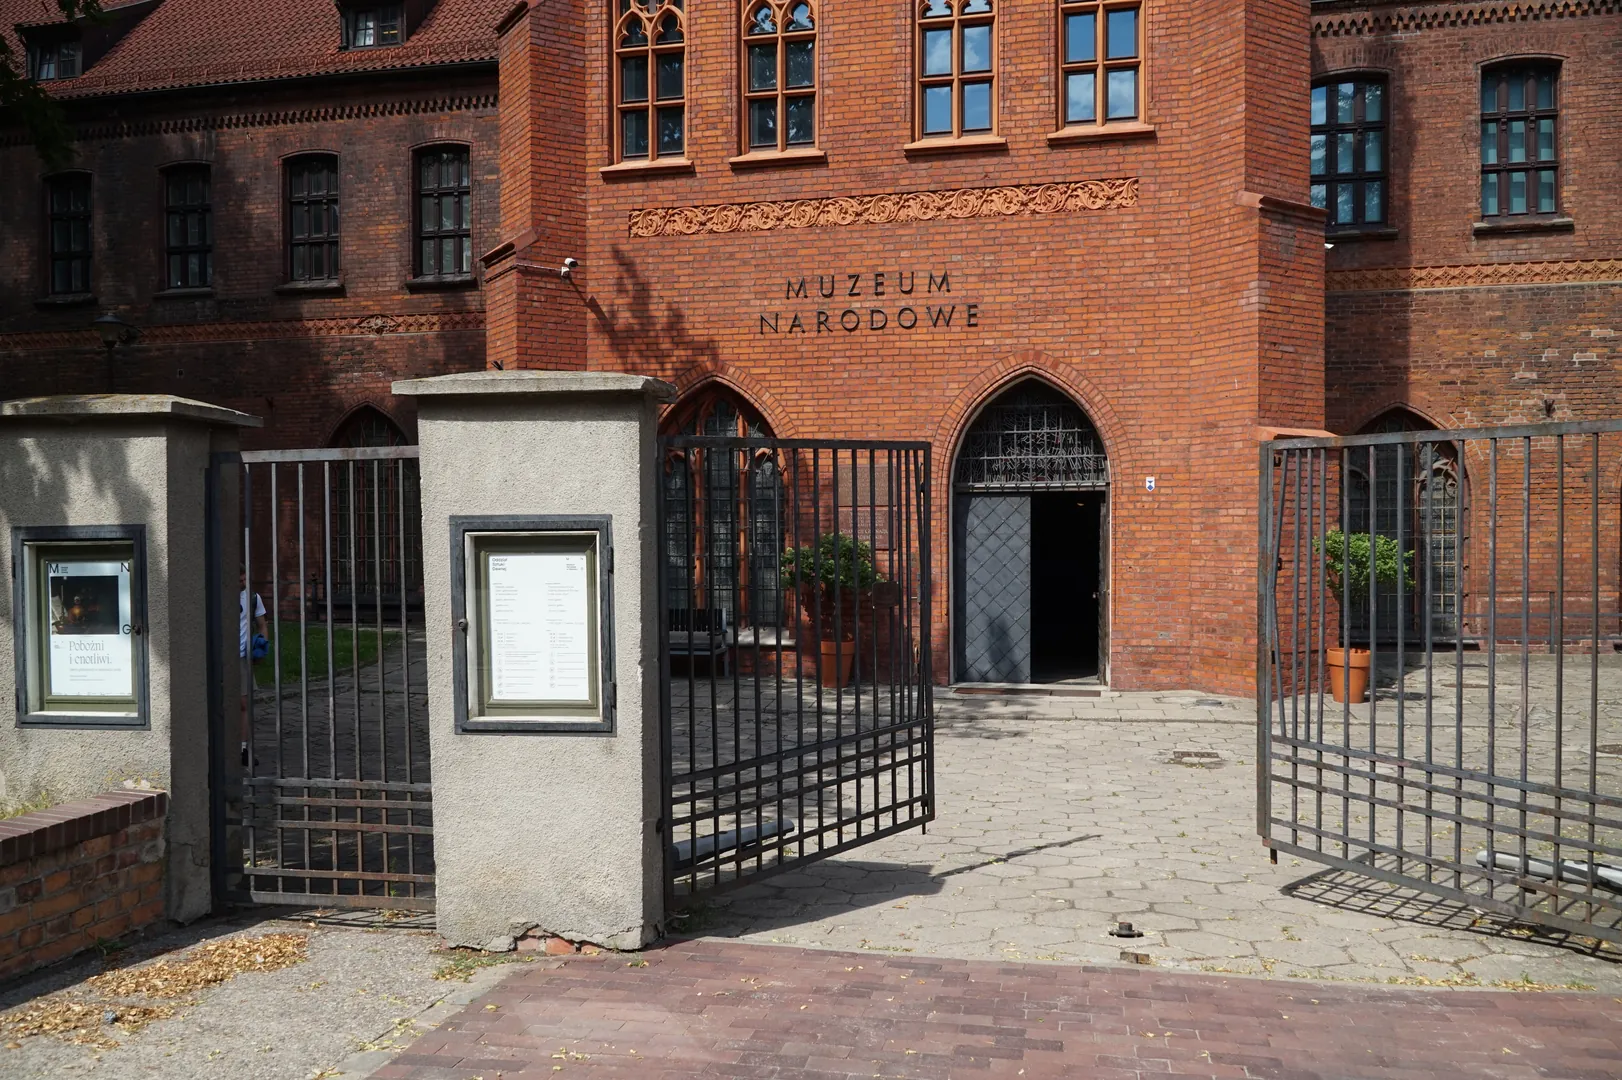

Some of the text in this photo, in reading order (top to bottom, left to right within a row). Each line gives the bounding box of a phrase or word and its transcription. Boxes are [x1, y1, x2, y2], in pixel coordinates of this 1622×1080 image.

[786, 271, 951, 300] MUZEUM
[760, 304, 979, 335] NARODOWE
[49, 563, 59, 574] M
[121, 562, 130, 572] N
[122, 624, 132, 635] G
[69, 640, 104, 651] Pobożni
